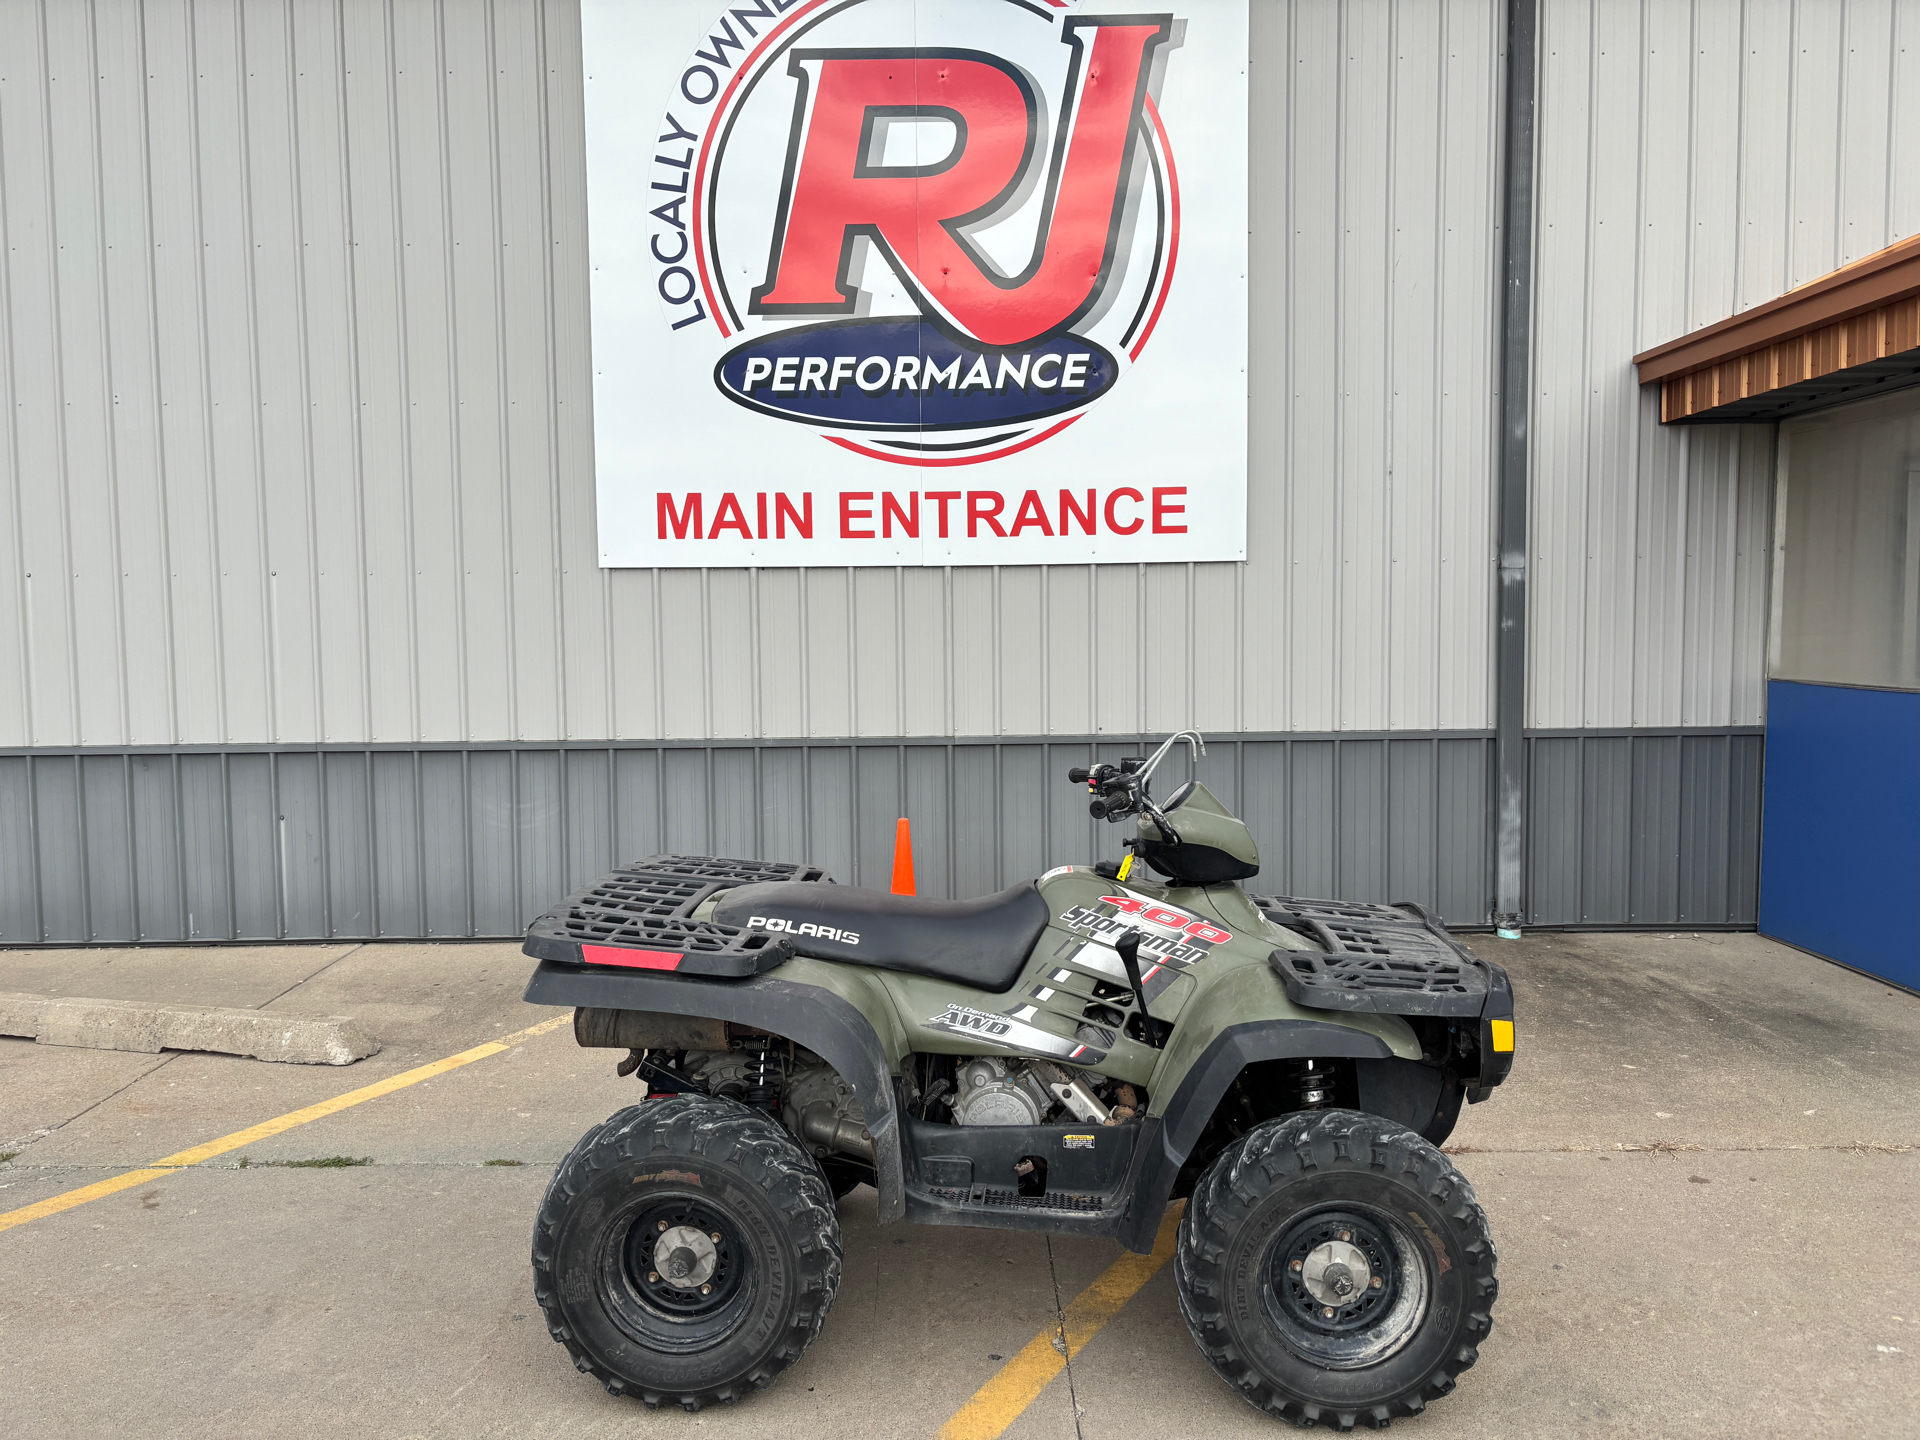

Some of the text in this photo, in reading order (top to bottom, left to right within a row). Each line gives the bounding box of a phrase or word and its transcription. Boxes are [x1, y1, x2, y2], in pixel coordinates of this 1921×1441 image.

[748, 13, 1174, 350] RJ
[648, 111, 707, 331] LOCALLY
[743, 353, 1091, 392] PERFORMANCE
[656, 486, 1188, 540] MAIN ENTRANCE
[746, 916, 860, 946] POLARIS
[1098, 895, 1234, 945] 400
[929, 1009, 1012, 1037] AWD
[947, 1003, 1012, 1022] On Demand
